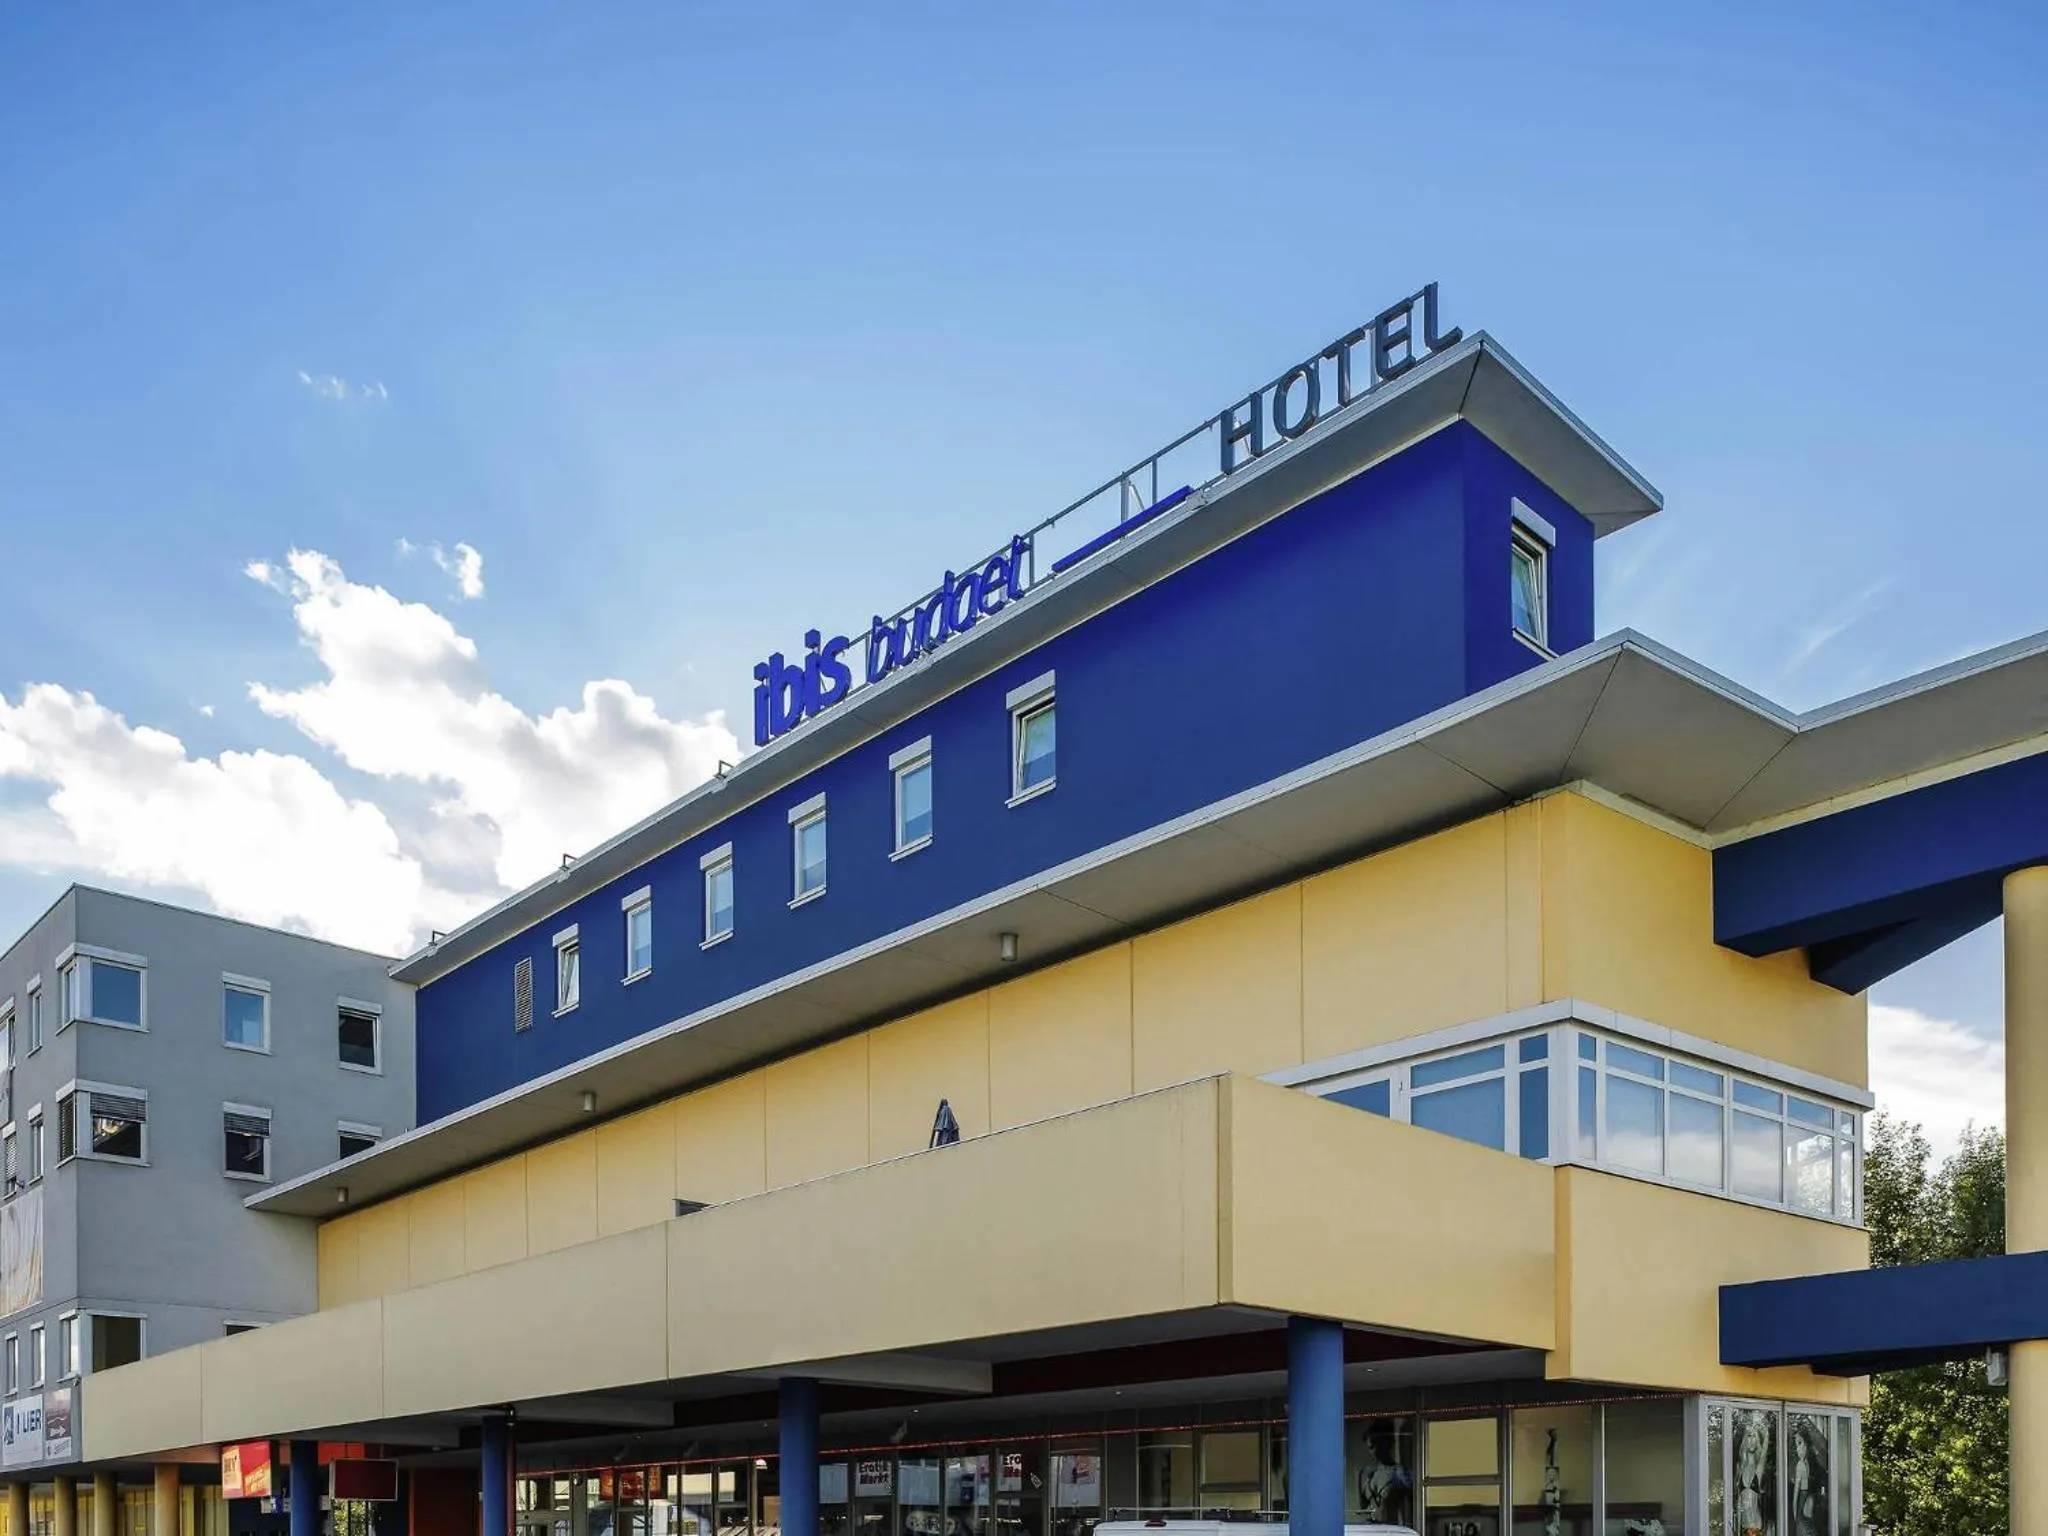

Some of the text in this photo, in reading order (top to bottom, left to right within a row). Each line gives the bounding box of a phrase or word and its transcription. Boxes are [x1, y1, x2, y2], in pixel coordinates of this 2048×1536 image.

[1220, 282, 1462, 475] HOTEL
[754, 534, 1029, 746] ibis budget
